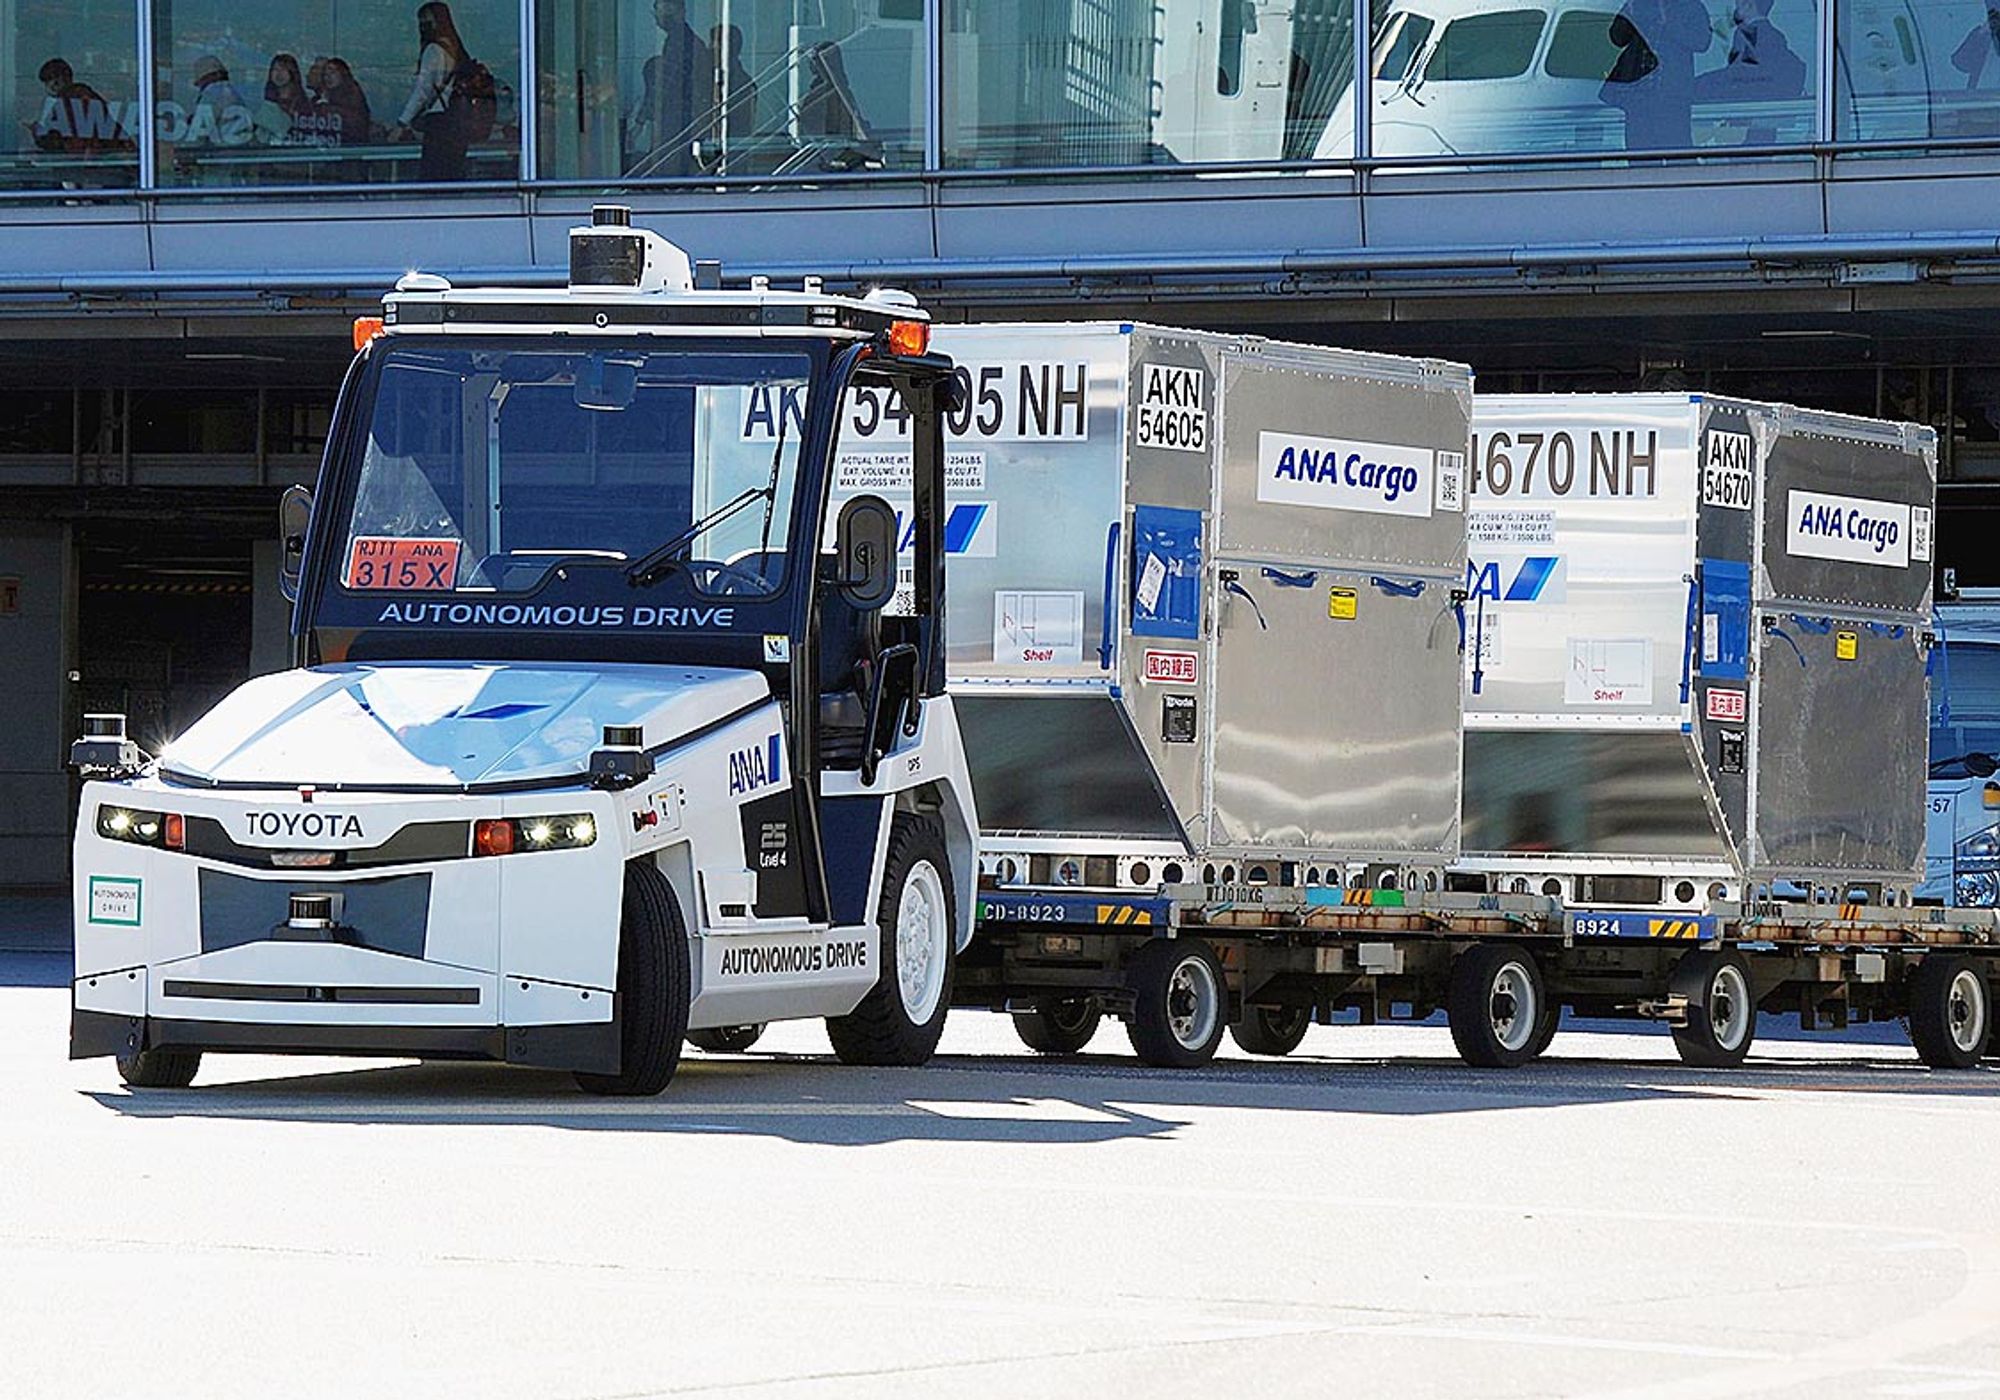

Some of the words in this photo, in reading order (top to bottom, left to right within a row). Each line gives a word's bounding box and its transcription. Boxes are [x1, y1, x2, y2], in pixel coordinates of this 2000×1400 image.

[853, 366, 1003, 437] 5405
[1017, 364, 1087, 437] NH
[1145, 367, 1201, 409] AKN
[1138, 407, 1204, 449] 54605
[1589, 430, 1657, 497] NH
[1709, 433, 1748, 471] AKN
[1273, 446, 1338, 485] ANA
[1343, 453, 1418, 502] Cargo
[1704, 469, 1751, 507] 54670
[1798, 503, 1843, 539] ANA
[1847, 508, 1899, 553] Cargo
[359, 540, 398, 556] RJTT
[411, 544, 443, 556] ANA
[378, 602, 625, 626] AUTONOMOUS
[631, 606, 736, 627] DRIVE
[1022, 649, 1054, 662] Shelf
[1593, 689, 1625, 701] Shelf
[729, 745, 768, 797] ANA
[245, 812, 365, 838] TOYOTA
[984, 903, 1066, 921] CD-8923
[1575, 919, 1621, 936] 8924
[720, 944, 822, 975] AUTONOMOUS
[825, 941, 867, 968] DRIVE
